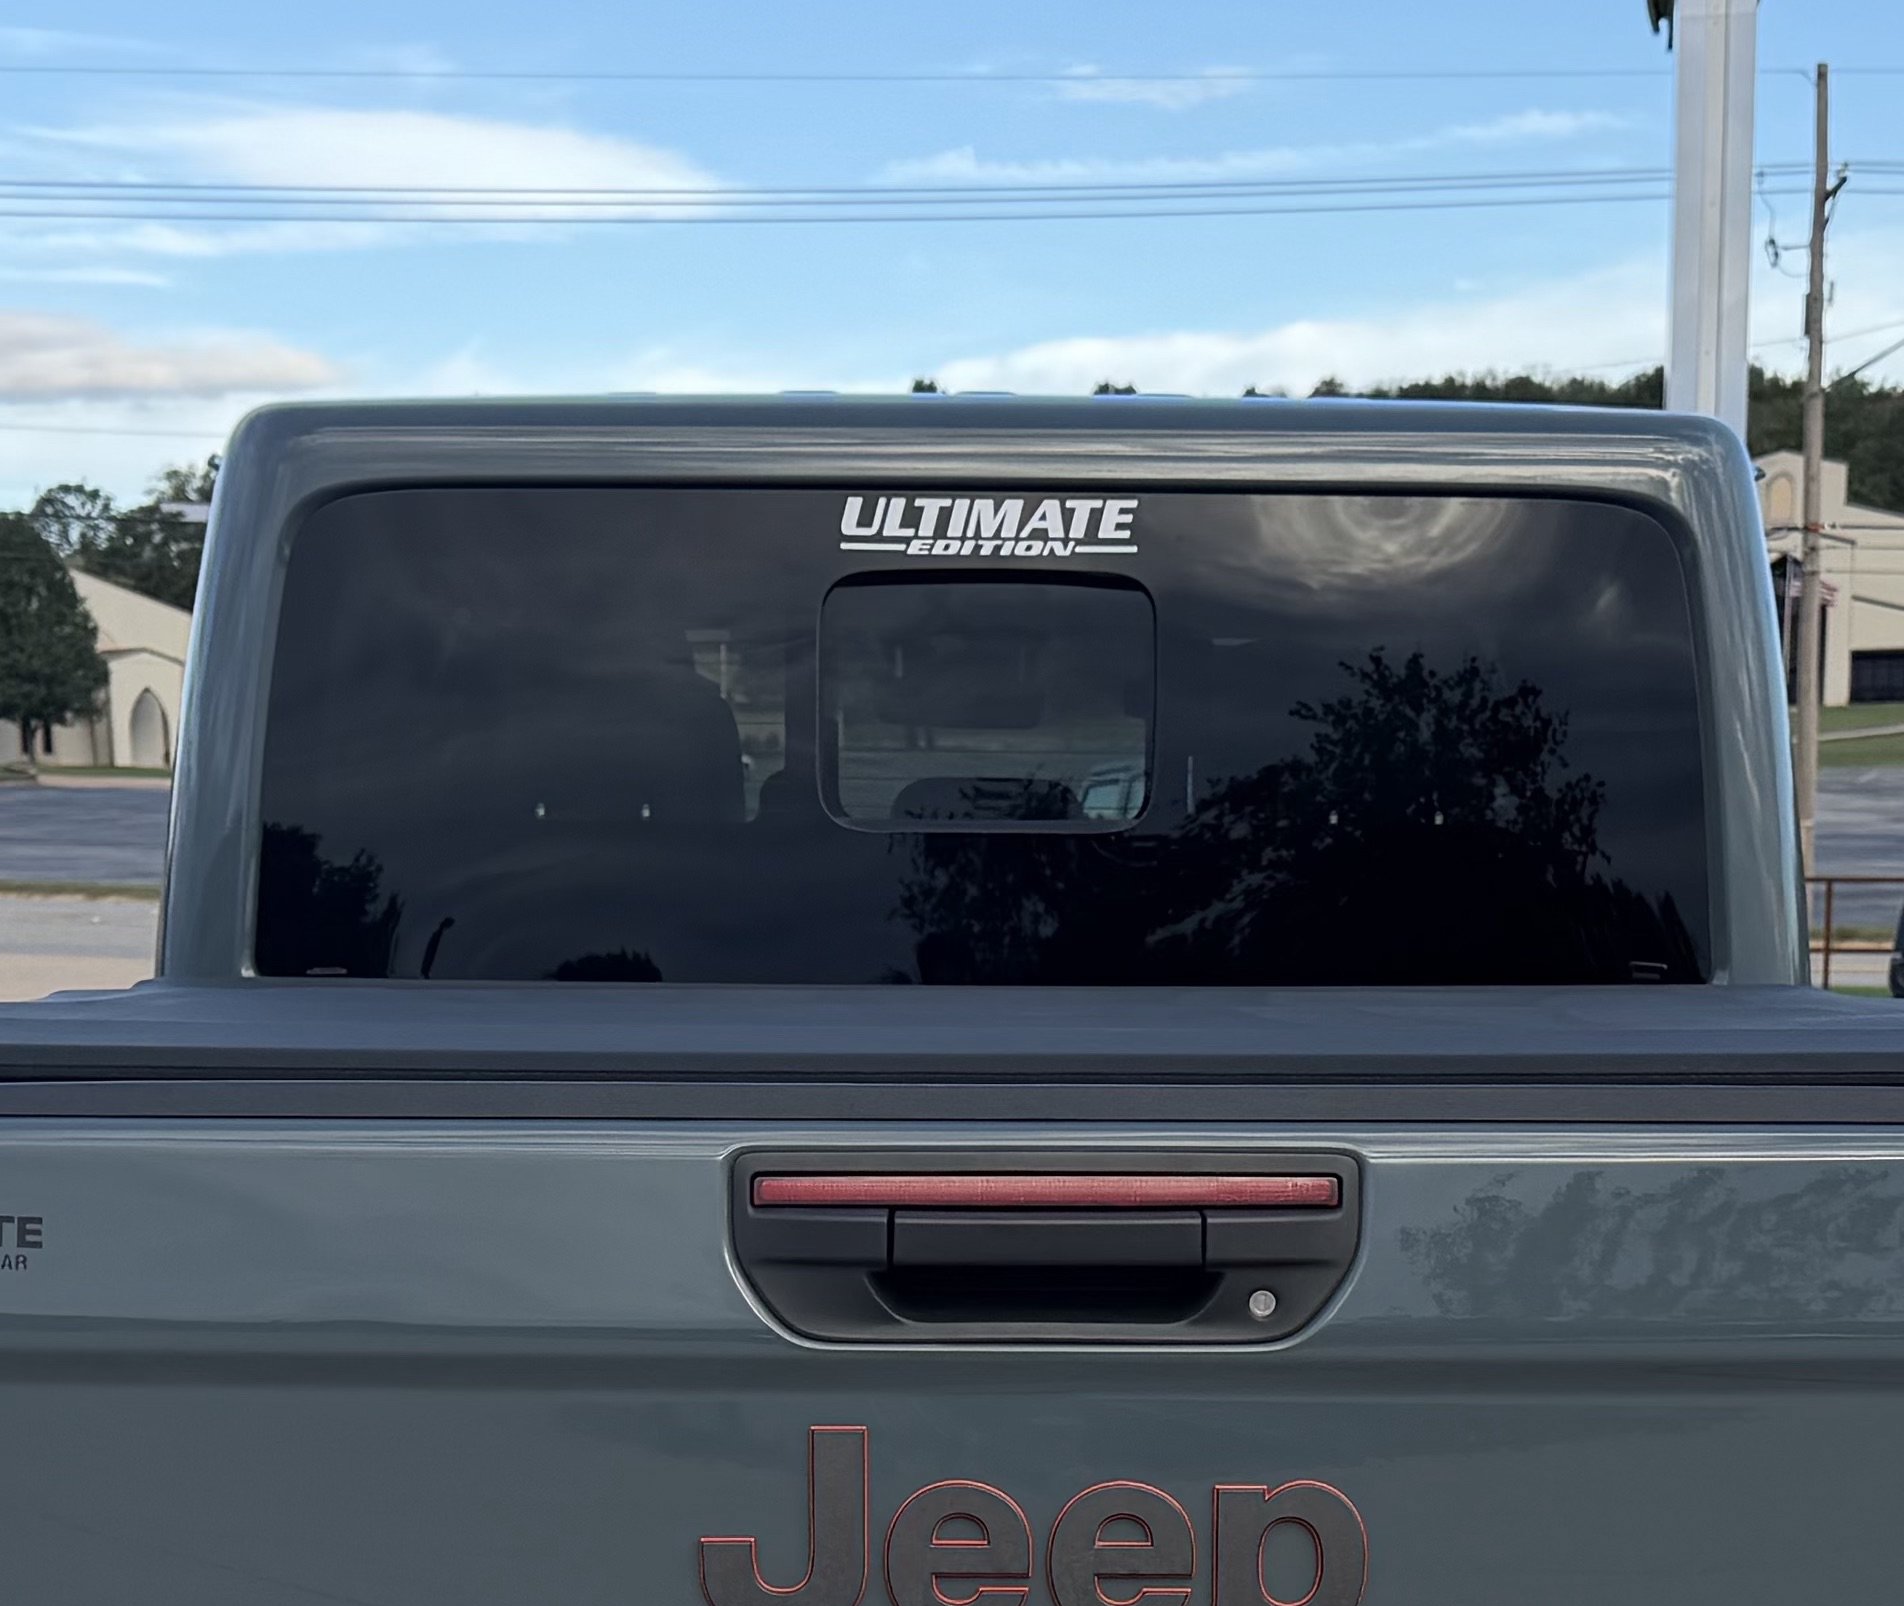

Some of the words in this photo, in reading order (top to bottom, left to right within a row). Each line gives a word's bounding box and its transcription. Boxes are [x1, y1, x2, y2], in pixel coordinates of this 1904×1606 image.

[840, 497, 1139, 538] ULTIMATE
[906, 540, 1076, 556] EDITION
[0, 1254, 28, 1271] AR
